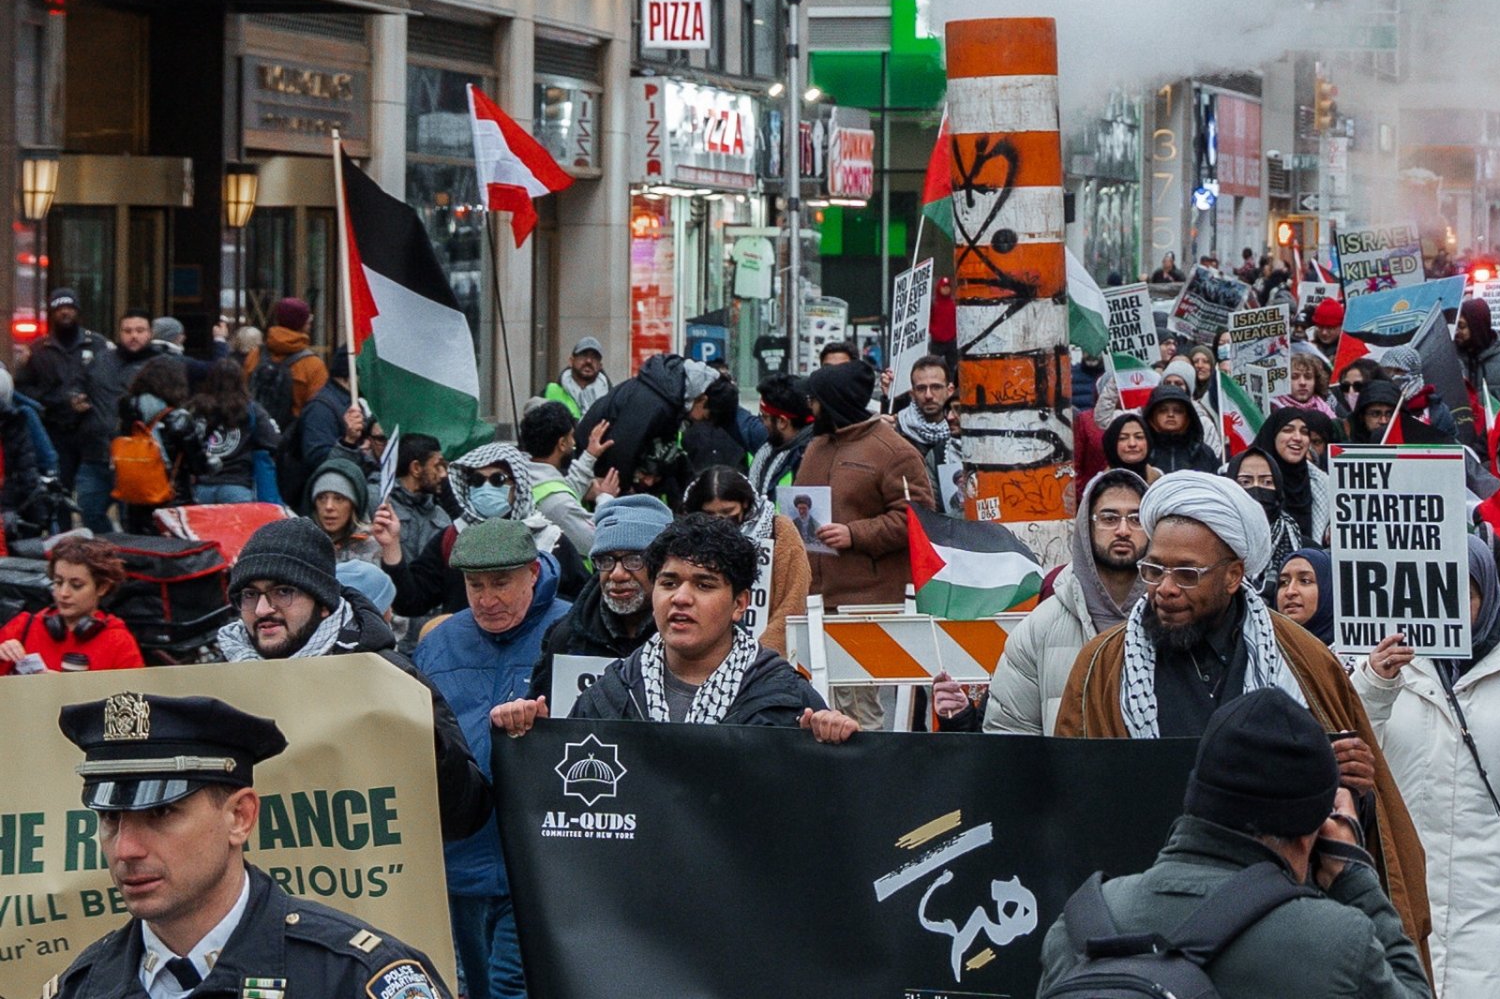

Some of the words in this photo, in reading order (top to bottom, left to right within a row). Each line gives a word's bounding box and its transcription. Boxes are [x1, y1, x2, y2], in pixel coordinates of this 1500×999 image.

[650, 1, 705, 41] PIZZA
[644, 83, 662, 176] PIZZA
[1339, 227, 1420, 255] ISRAEL
[1344, 255, 1417, 281] KILLED
[1107, 295, 1142, 314] SRAEL
[1233, 307, 1284, 328] ISRAEL
[1140, 333, 1155, 346] TO
[1230, 321, 1287, 343] WEAKER
[1334, 462, 1392, 489] THEY
[1336, 494, 1445, 522] STARTED
[1336, 524, 1378, 550] THE
[1385, 524, 1441, 550] WAR
[1339, 560, 1460, 619] IRAN
[1341, 623, 1386, 646] WILL
[1397, 623, 1436, 647] END
[1443, 624, 1463, 648] IT
[541, 811, 637, 831] AL-QUDS
[541, 829, 582, 838] COMMITTEE
[584, 830, 594, 838] OF
[596, 831, 613, 839] NEW
[615, 832, 634, 840] YORK
[81, 889, 130, 917] BE
[383, 965, 415, 985] POLICE
